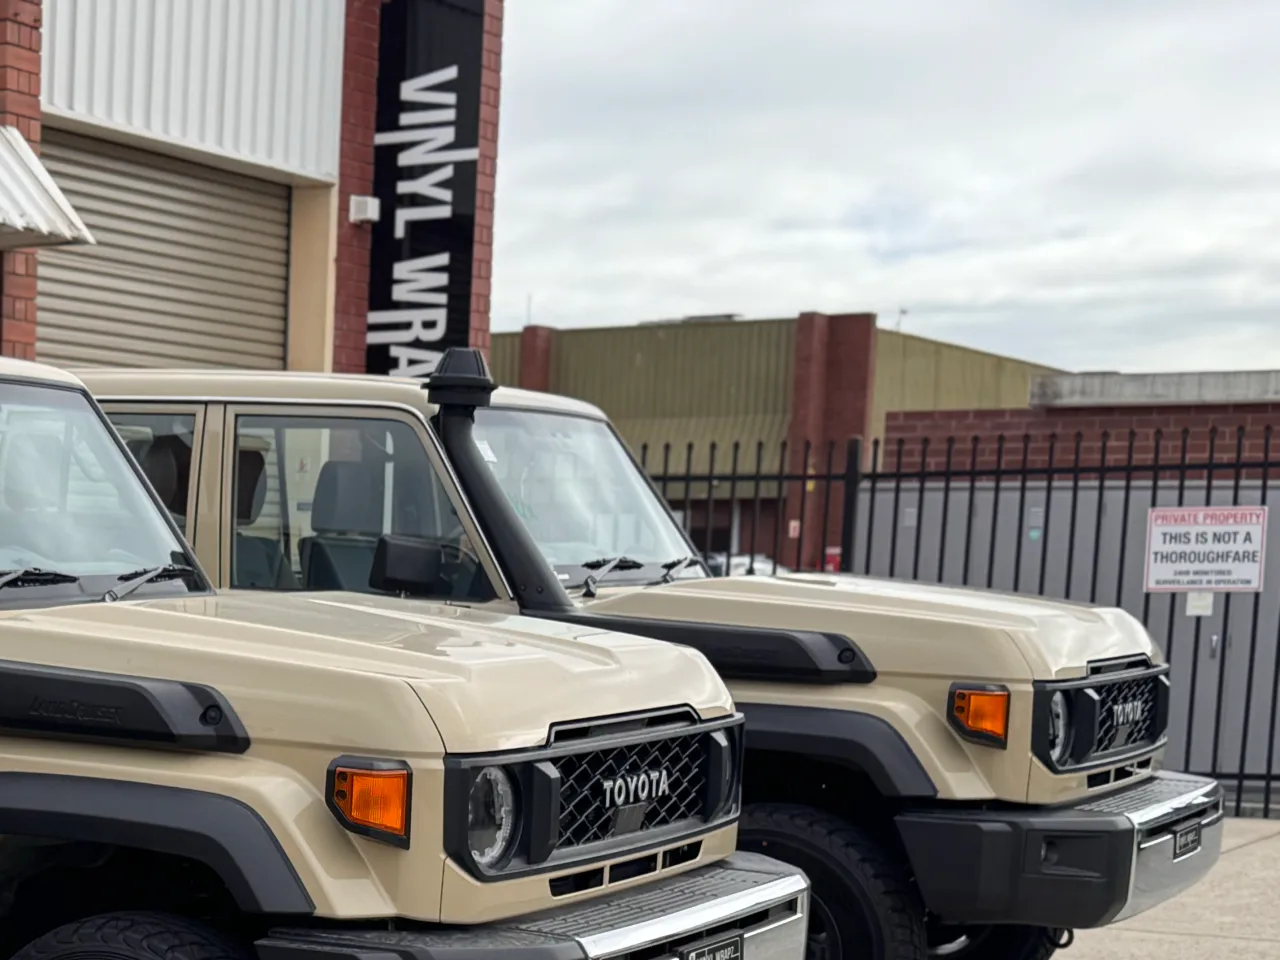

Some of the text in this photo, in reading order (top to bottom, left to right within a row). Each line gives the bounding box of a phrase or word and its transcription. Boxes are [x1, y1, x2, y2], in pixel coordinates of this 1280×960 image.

[376, 65, 477, 239] VINYL
[1154, 512, 1261, 525] PRIVATE PROPERTY
[1161, 531, 1252, 545] THIS IS NOT A
[1152, 550, 1259, 564] THOROUGHFARE
[1113, 700, 1141, 726] TOYOTA
[603, 769, 669, 807] TOYOTA
